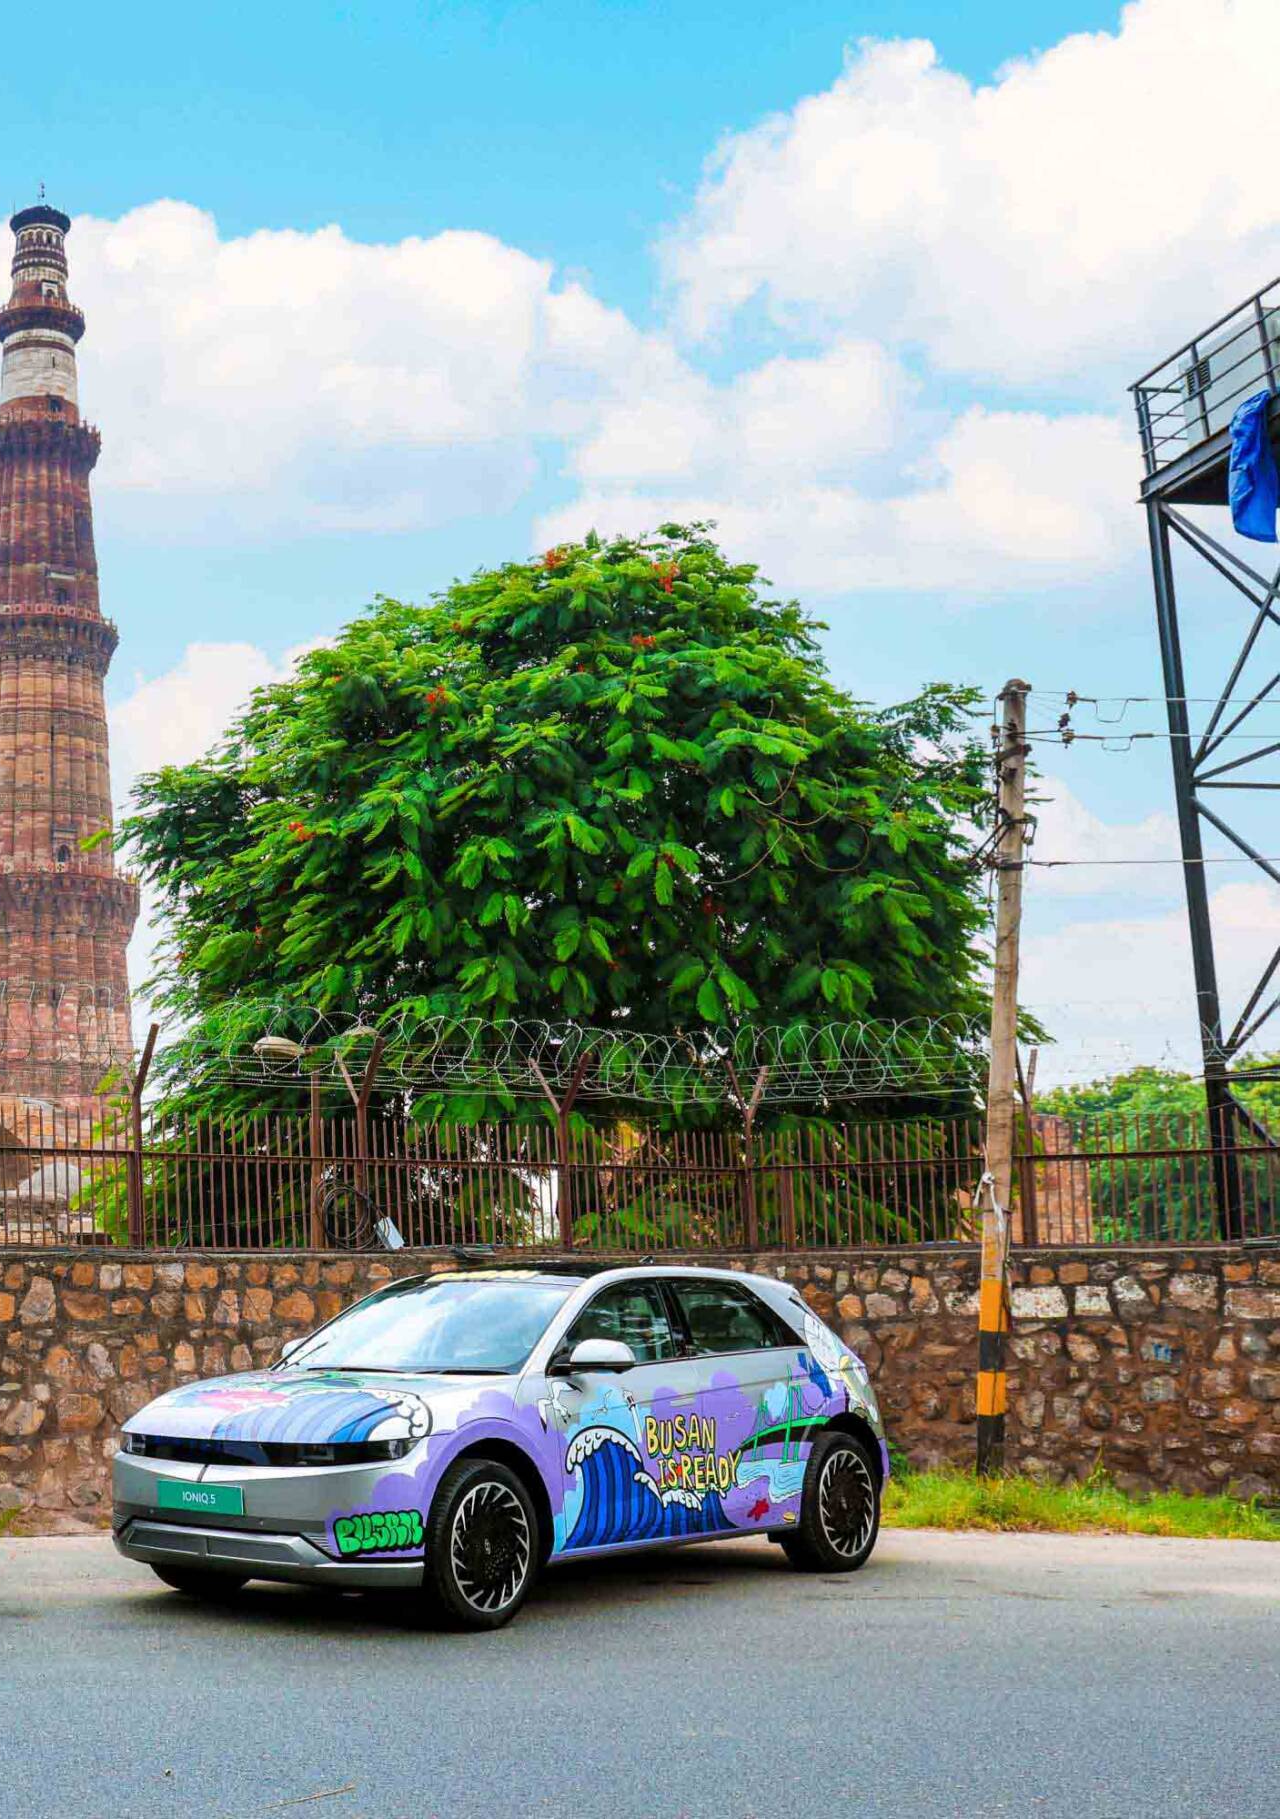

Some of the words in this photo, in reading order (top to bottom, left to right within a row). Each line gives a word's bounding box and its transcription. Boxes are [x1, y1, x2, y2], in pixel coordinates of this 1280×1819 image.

[644, 1413, 716, 1459] BUSAN
[658, 1457, 679, 1491] IS
[680, 1448, 742, 1494] READY
[182, 1491, 209, 1505] IONIQ
[210, 1493, 216, 1505] 5
